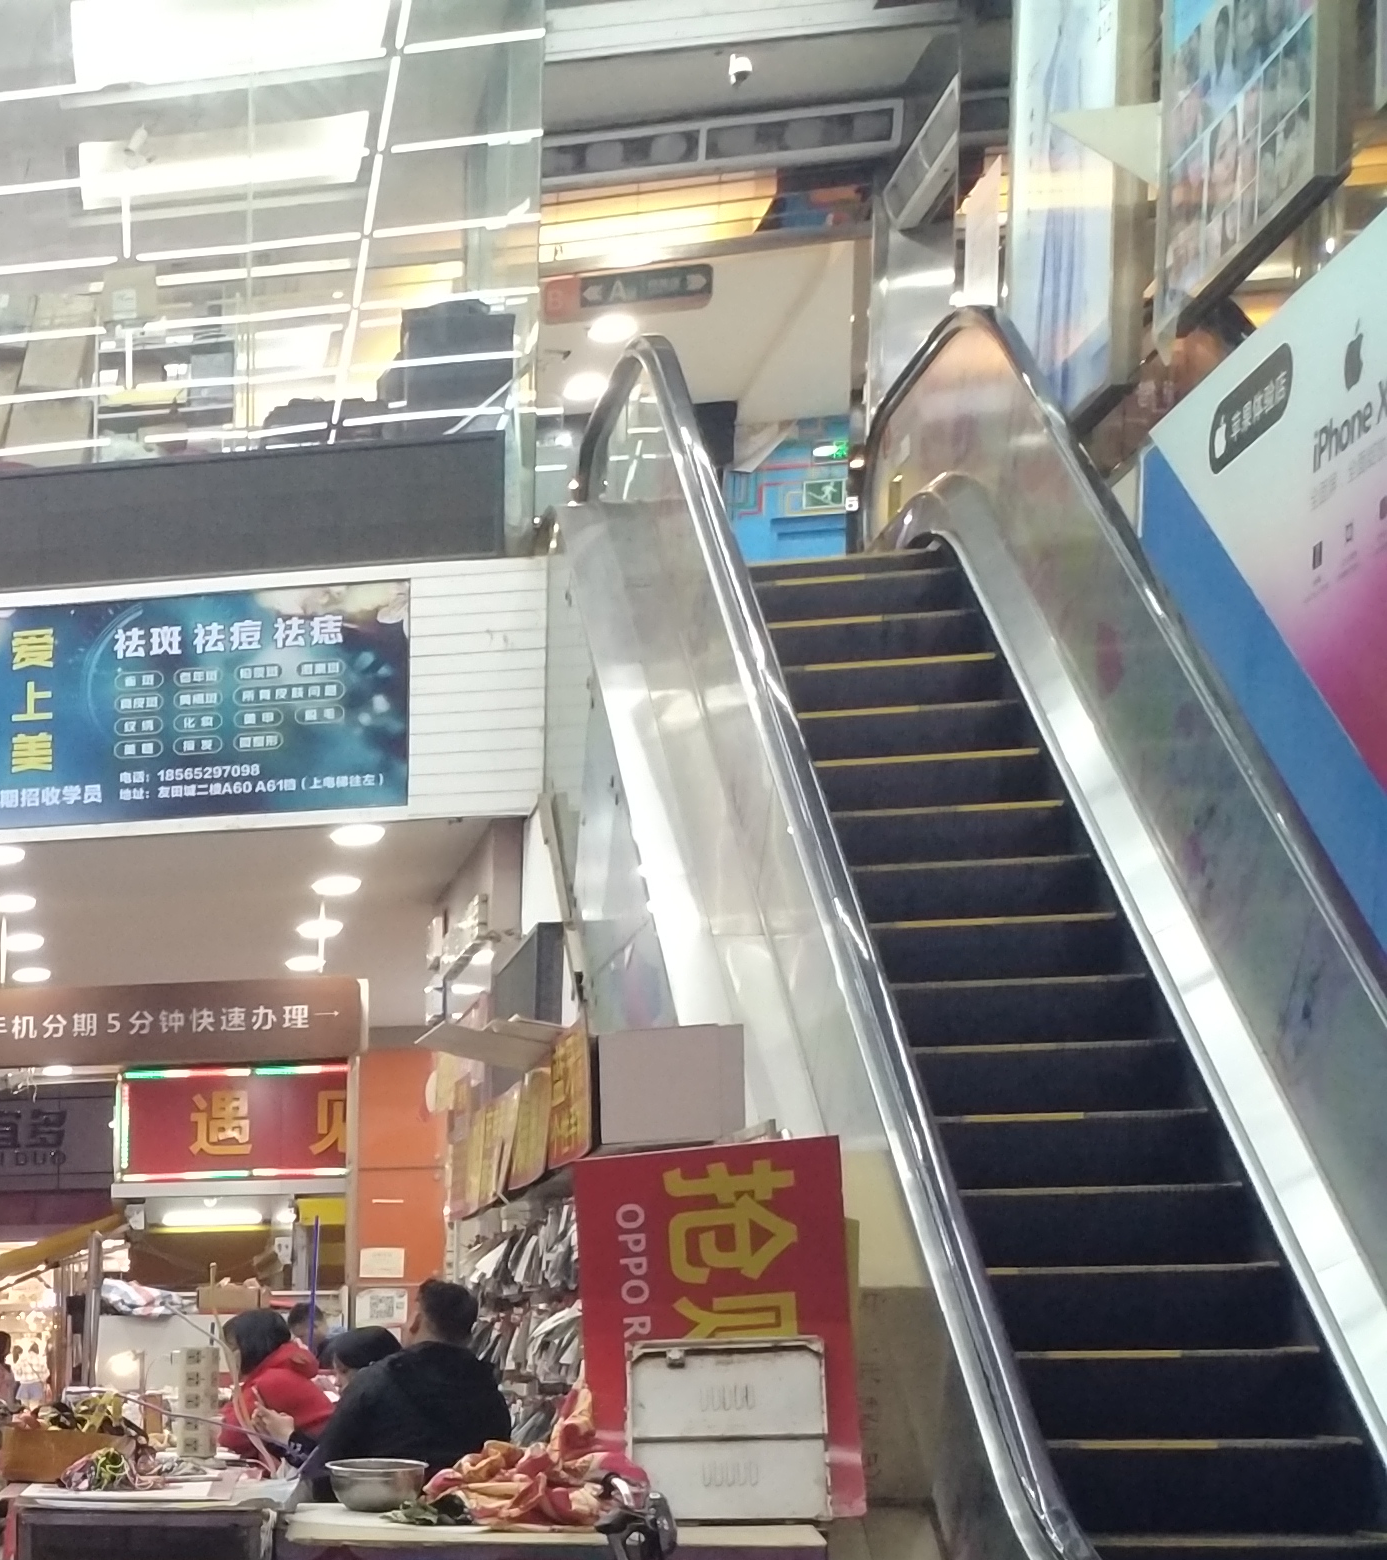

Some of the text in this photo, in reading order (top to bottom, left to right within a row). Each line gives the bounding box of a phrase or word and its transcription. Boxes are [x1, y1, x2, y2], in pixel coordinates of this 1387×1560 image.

[1312, 400, 1373, 474] iPhone
[114, 613, 344, 661] 祛斑 祛痘 祛痣
[11, 627, 54, 774] 爱上美
[615, 1203, 650, 1312] OPPO
